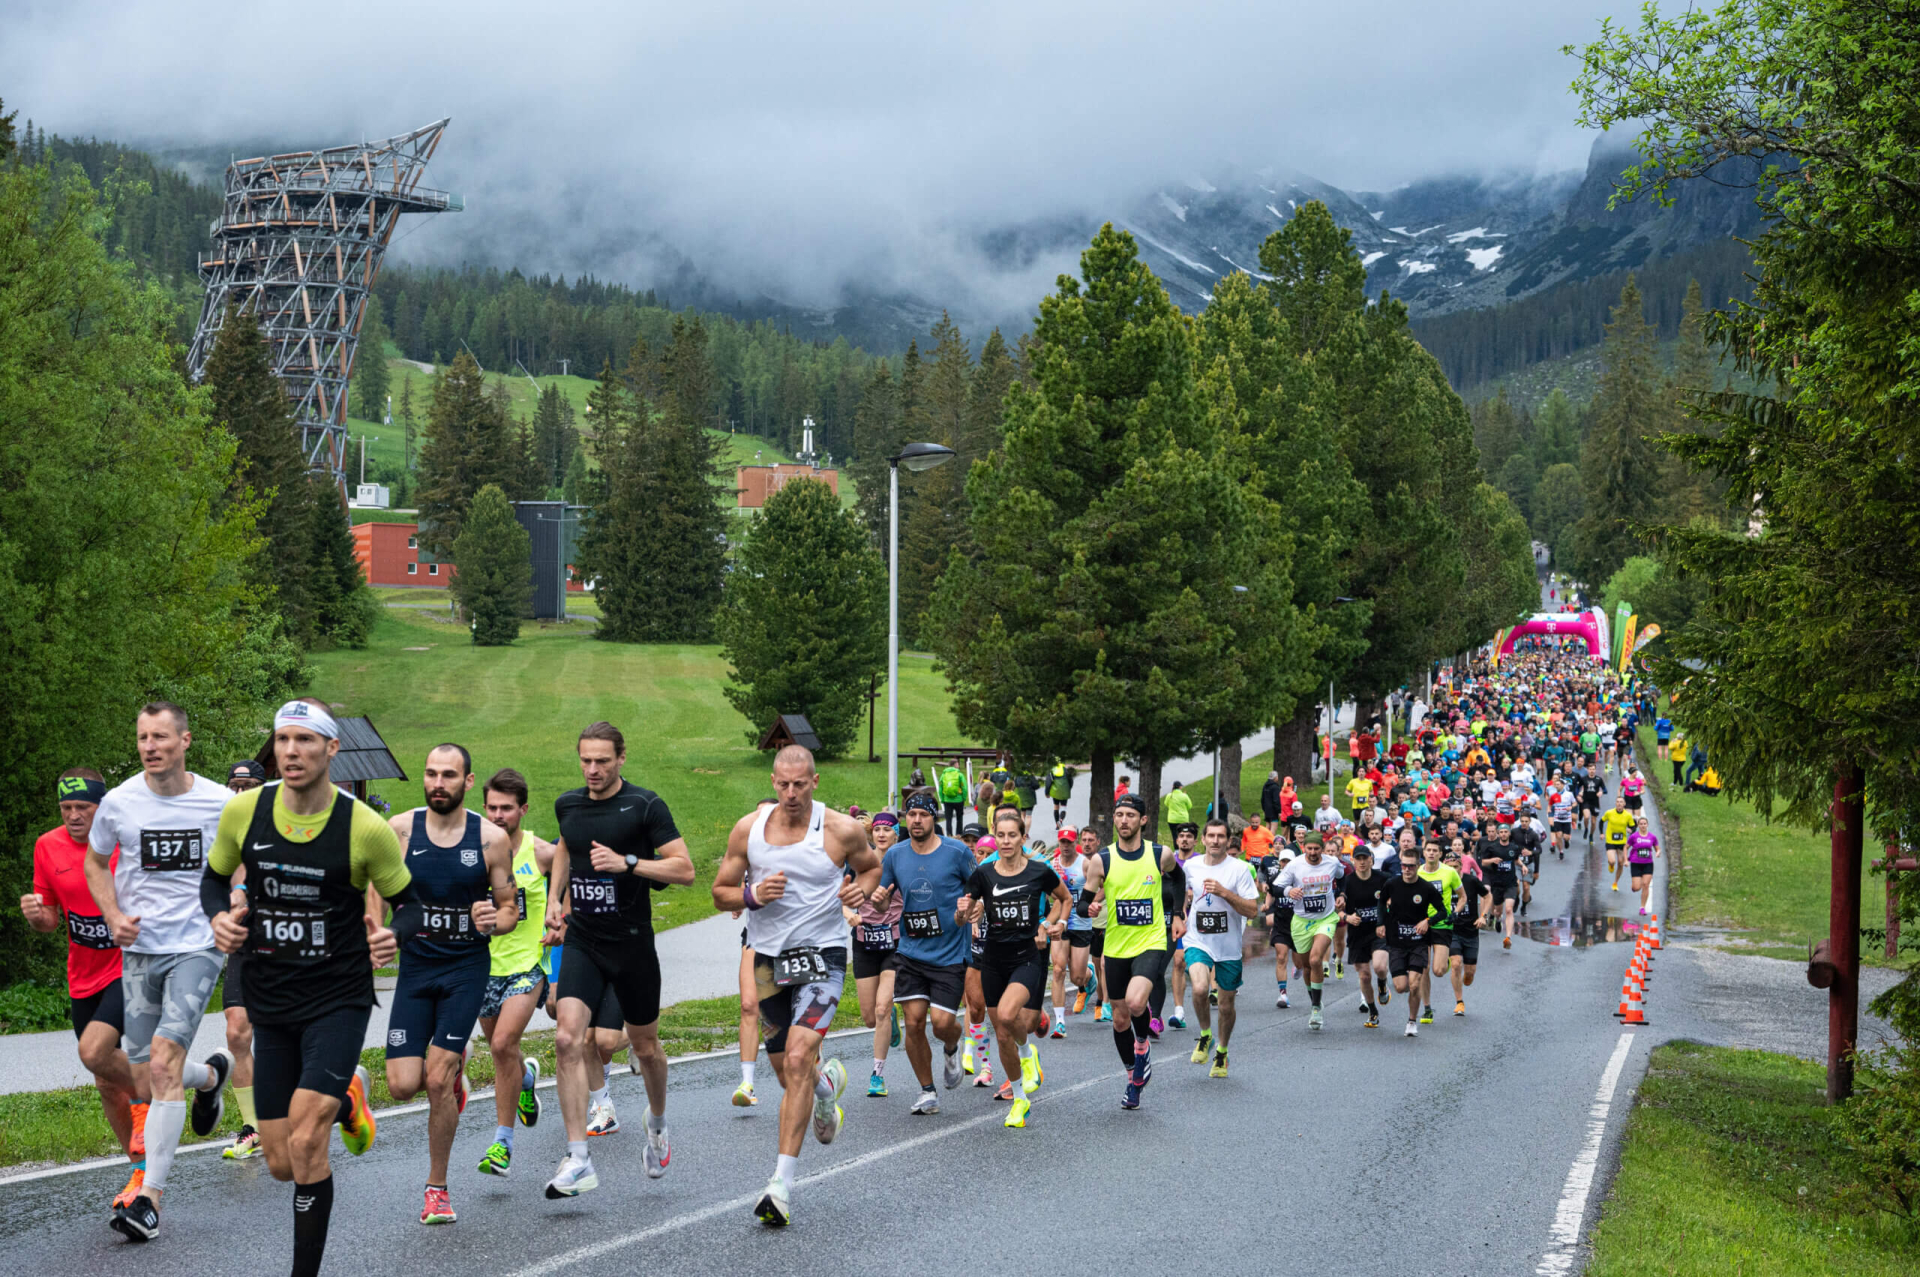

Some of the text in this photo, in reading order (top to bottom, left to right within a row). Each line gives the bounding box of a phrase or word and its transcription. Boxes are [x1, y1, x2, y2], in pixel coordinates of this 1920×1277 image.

[149, 840, 183, 857] 137
[571, 883, 605, 901] 1159
[1304, 899, 1322, 908] 1317
[995, 906, 1018, 918] 169
[1117, 905, 1146, 917] 1124
[423, 912, 451, 929] 161
[908, 918, 928, 930] 199
[1202, 917, 1215, 927] 83
[69, 919, 108, 938] 1228
[262, 919, 304, 942] 160
[864, 931, 886, 942] 1253
[781, 955, 811, 973] 133
